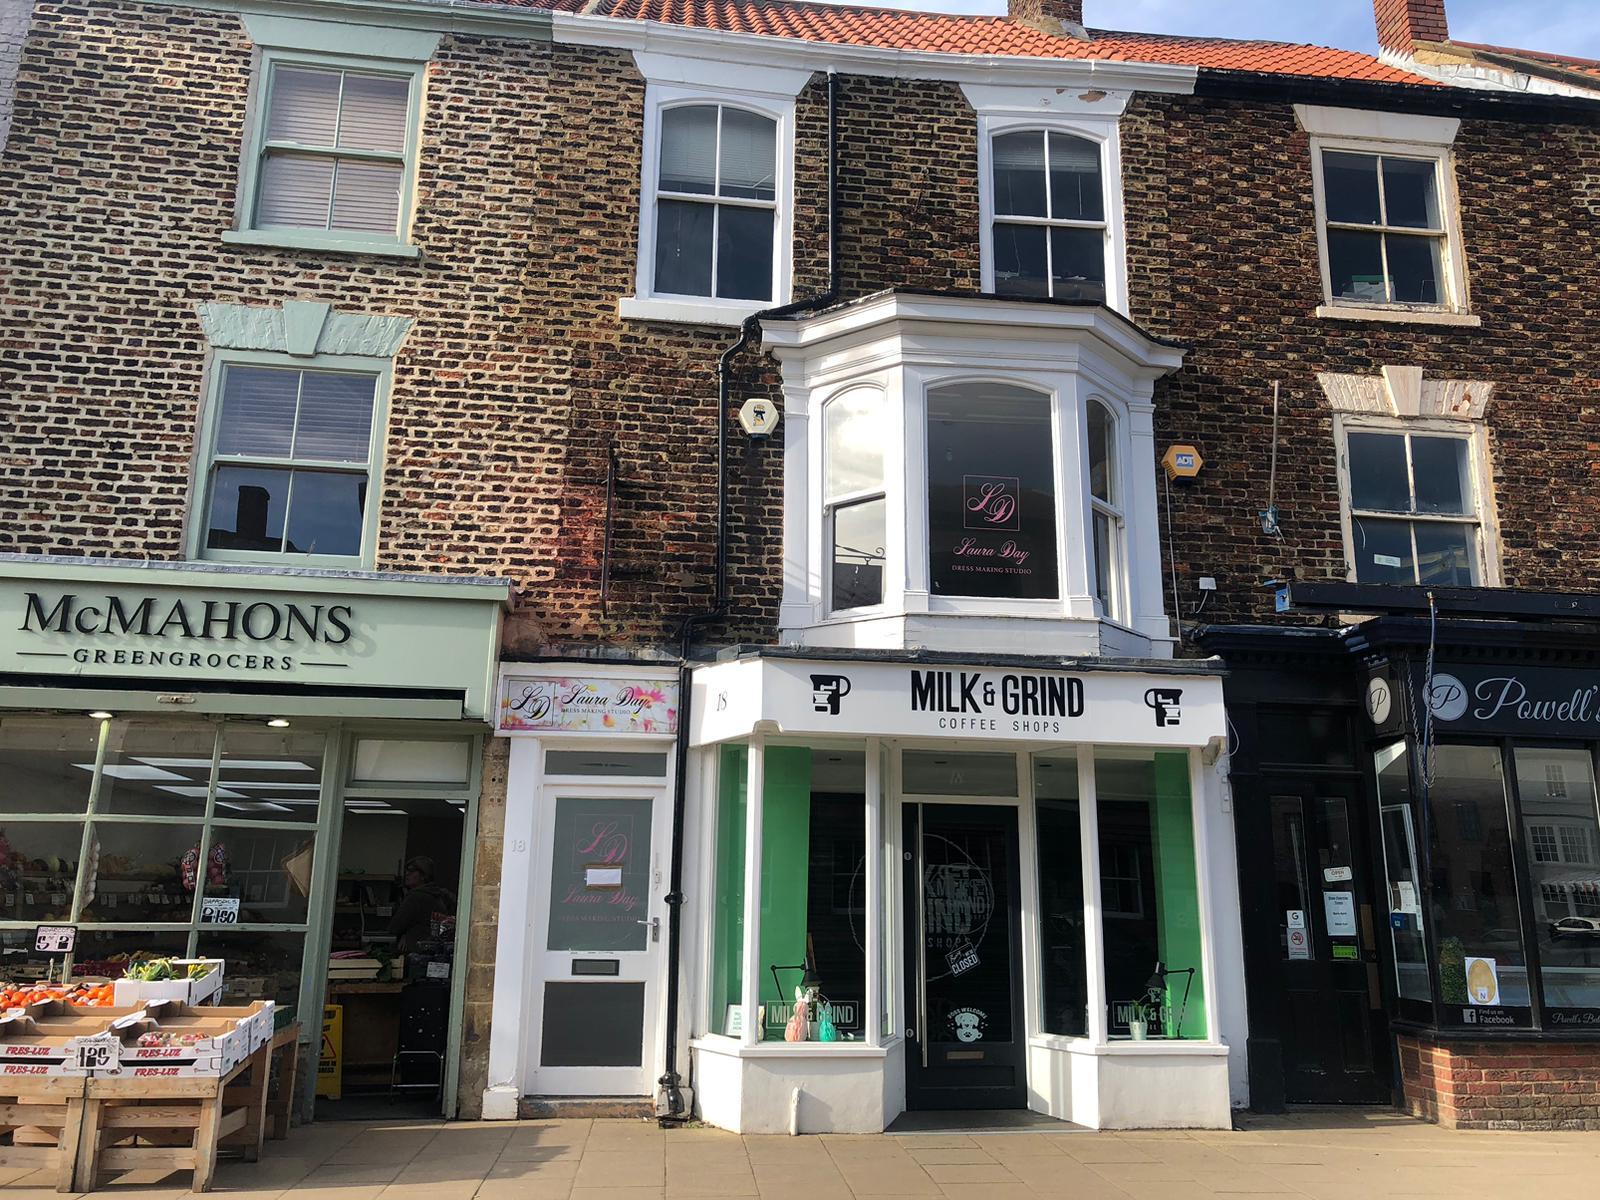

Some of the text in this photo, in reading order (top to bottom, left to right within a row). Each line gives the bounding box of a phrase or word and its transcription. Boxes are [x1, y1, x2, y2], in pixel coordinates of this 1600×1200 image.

[1176, 455, 1194, 465] ADT
[953, 537, 1031, 565] Laura Day
[951, 564, 1032, 575] DRESS MAKING STUDIO
[18, 592, 353, 645] McMAHONS
[73, 648, 293, 671] GREENGROCERS
[561, 684, 651, 714] Laura Day
[716, 690, 728, 712] 18
[911, 670, 1084, 718] MILK & GRIND
[938, 717, 1060, 733] COFFEE SHOPS
[951, 953, 979, 975] CLOSED
[961, 1007, 988, 1019] WELCOME
[1480, 1015, 1516, 1025] Facebook
[5, 1046, 51, 1056] FRES-LUZ
[136, 1048, 182, 1058] FRES-LUZ
[4, 1065, 49, 1075] FRES-LUZ
[134, 1067, 180, 1077] FRES-LUZ
